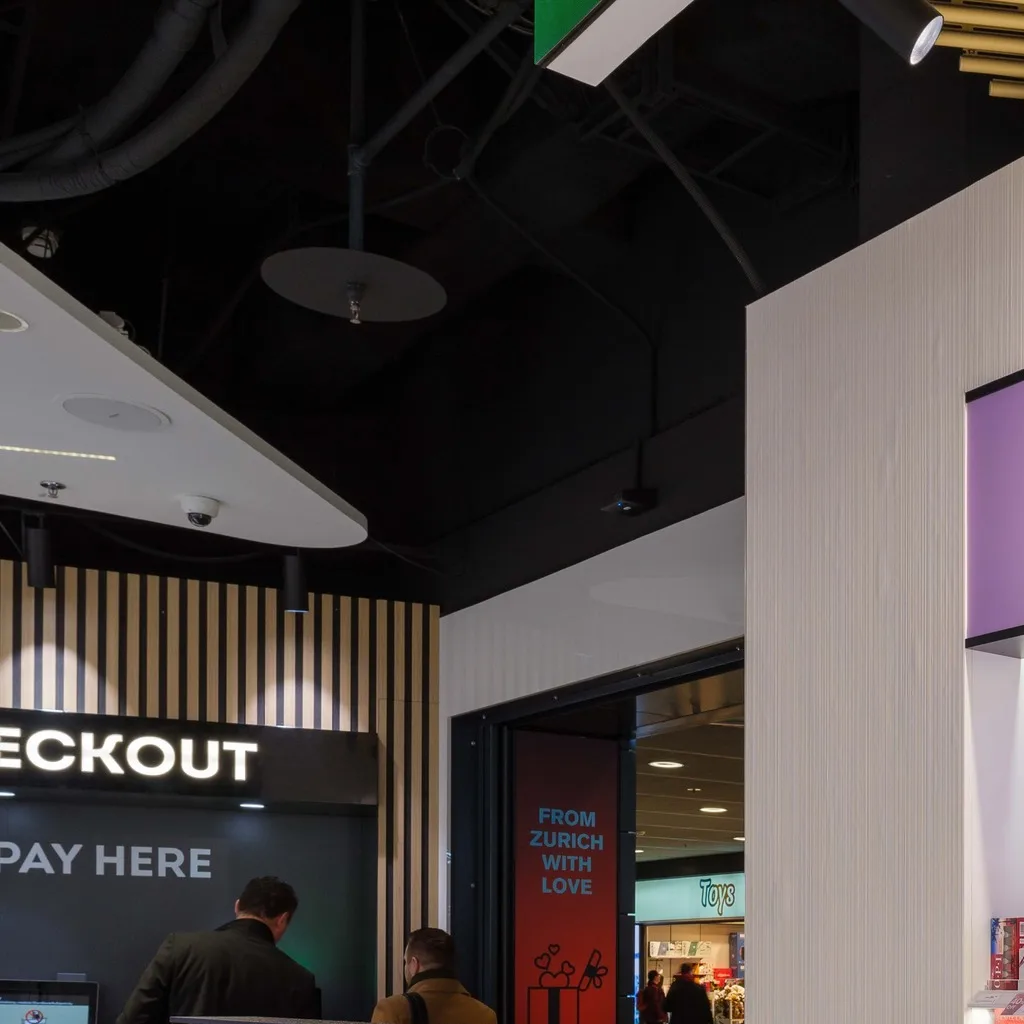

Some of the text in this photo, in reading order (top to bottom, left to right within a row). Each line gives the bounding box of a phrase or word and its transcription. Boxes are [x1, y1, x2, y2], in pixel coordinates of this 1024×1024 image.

[538, 808, 596, 827] FROM
[529, 830, 604, 850] ZURICH
[0, 841, 212, 878] PAY HERE
[541, 854, 592, 872] WITH
[541, 877, 593, 895] LOVE
[699, 878, 736, 916] Toys
